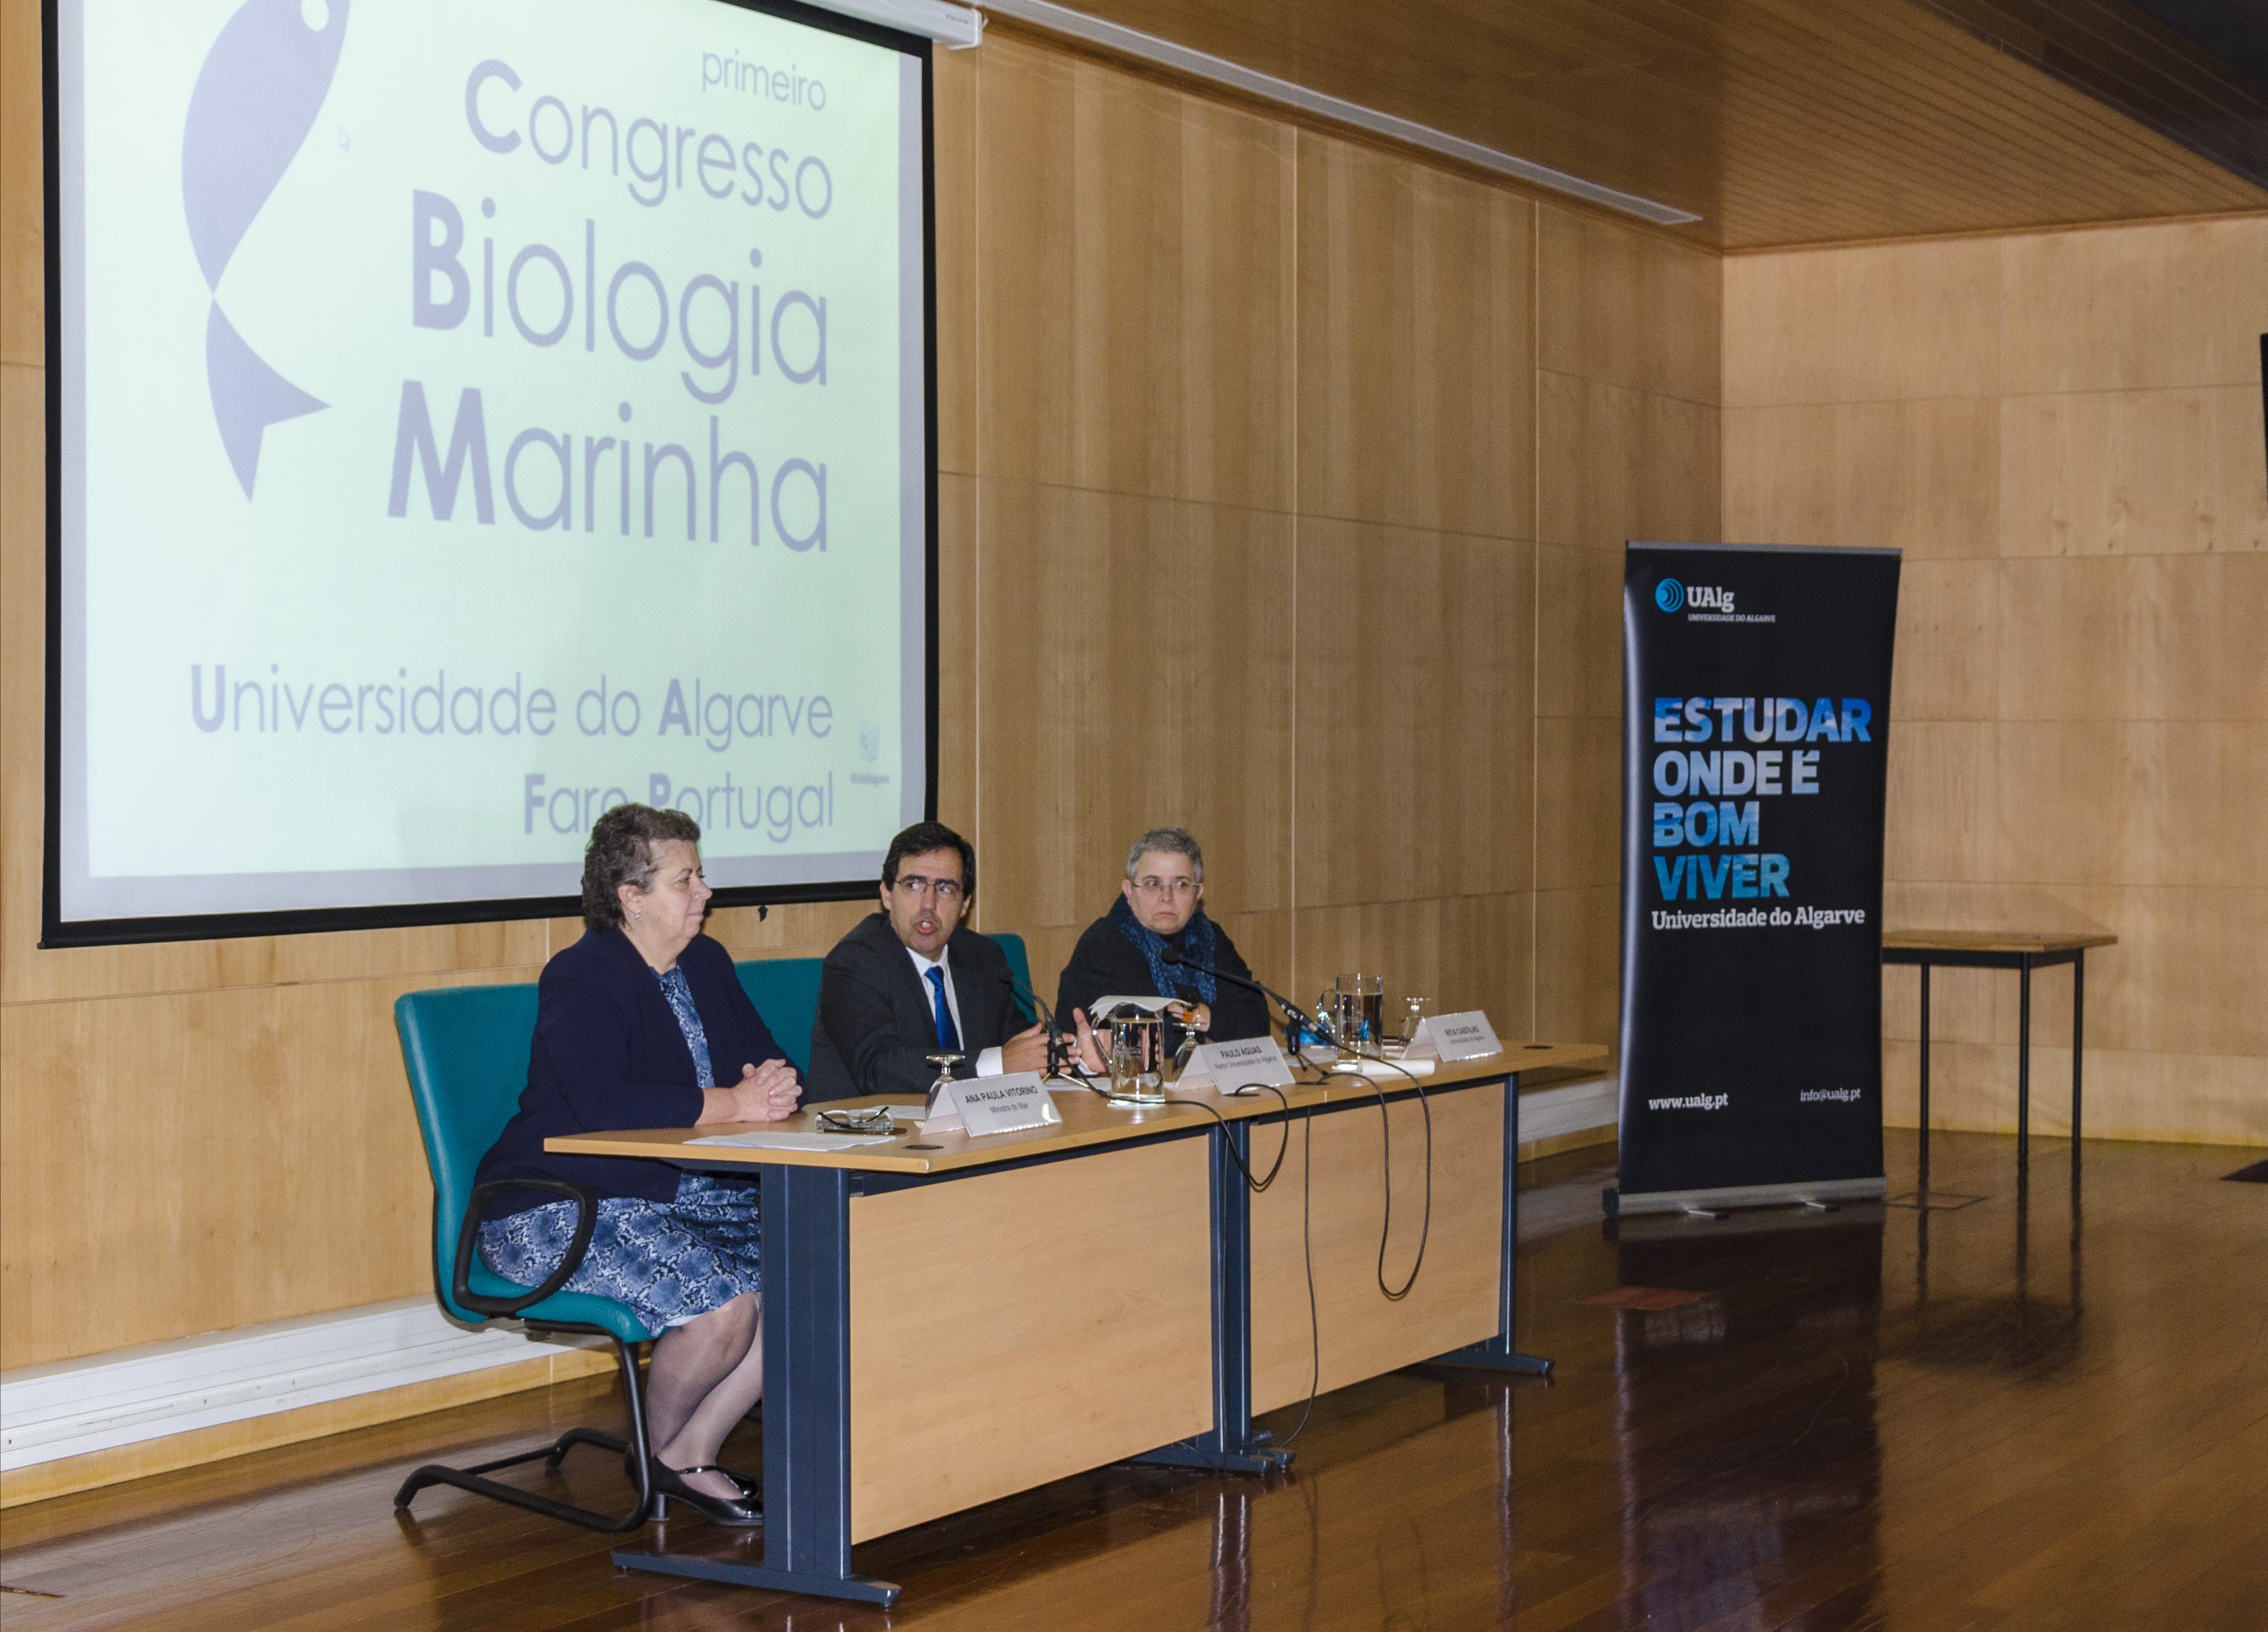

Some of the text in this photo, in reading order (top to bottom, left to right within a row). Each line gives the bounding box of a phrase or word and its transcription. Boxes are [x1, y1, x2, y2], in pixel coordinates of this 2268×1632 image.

[702, 49, 826, 111] primeiro
[465, 59, 833, 219] Congresso
[412, 188, 828, 404] Biologia
[387, 379, 828, 553] Marinha
[1687, 586, 1735, 613] UAlg
[190, 664, 832, 752] Universidade do Algarve
[1654, 697, 1872, 743] ESTUDAR
[1653, 749, 1820, 796] ONDE É
[649, 771, 833, 843] Portugal
[1653, 801, 1760, 847] BOM
[1653, 853, 1791, 901] VIVER
[1652, 906, 1865, 930] Universidade do Algarve
[1220, 1045, 1262, 1058] PAULO ÁGUAS
[965, 1085, 1038, 1104] ANA PAULA VITORINO
[989, 1104, 1011, 1113] Ministra
[1649, 1092, 1728, 1110] www.ualg.pt
[1800, 1088, 1861, 1102] info@ualg.pt
